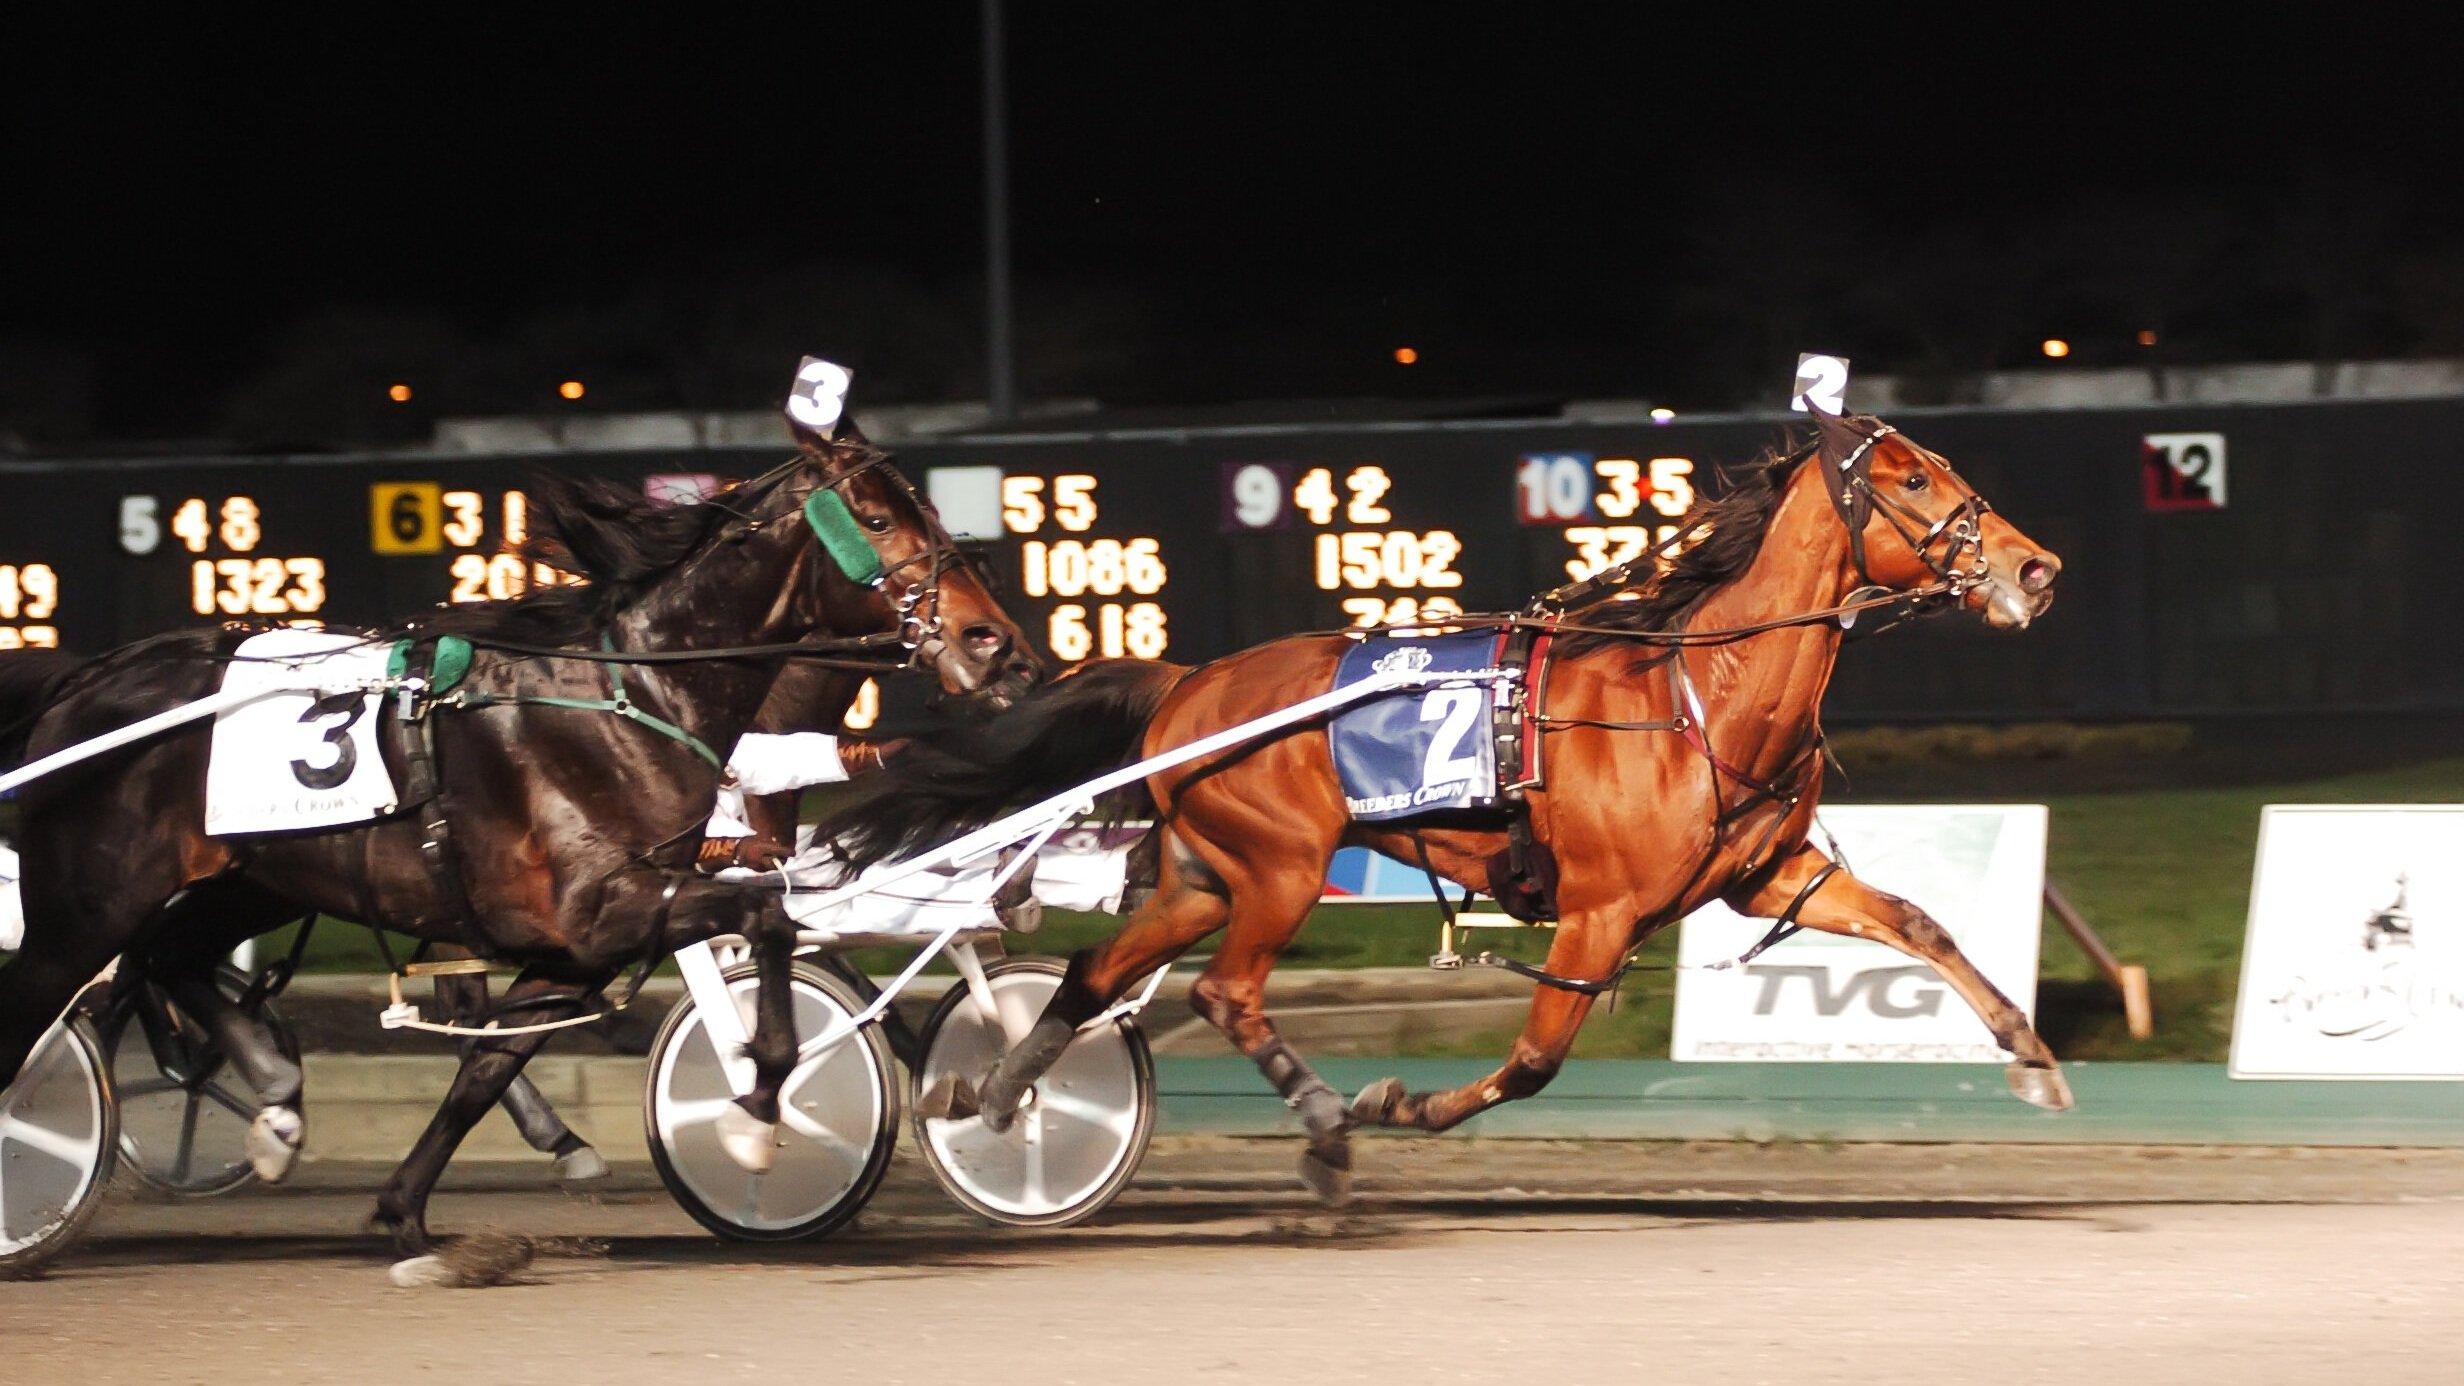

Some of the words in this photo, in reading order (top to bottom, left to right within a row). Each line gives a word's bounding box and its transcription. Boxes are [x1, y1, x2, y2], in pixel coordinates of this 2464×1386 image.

[789, 362, 848, 425] 3
[1791, 356, 1847, 415] 2
[1233, 464, 1281, 527] 9
[1518, 457, 1588, 519] 10
[2150, 444, 2212, 500] 12
[119, 495, 160, 554] 5
[391, 493, 424, 542] 6
[192, 557, 326, 614] 1323
[1023, 538, 1167, 597] 1086
[1315, 530, 1463, 589] 1502
[1050, 602, 1168, 661] 618
[289, 688, 367, 790] 3
[1420, 688, 1482, 788] 2
[1744, 964, 1946, 1019] TVG
